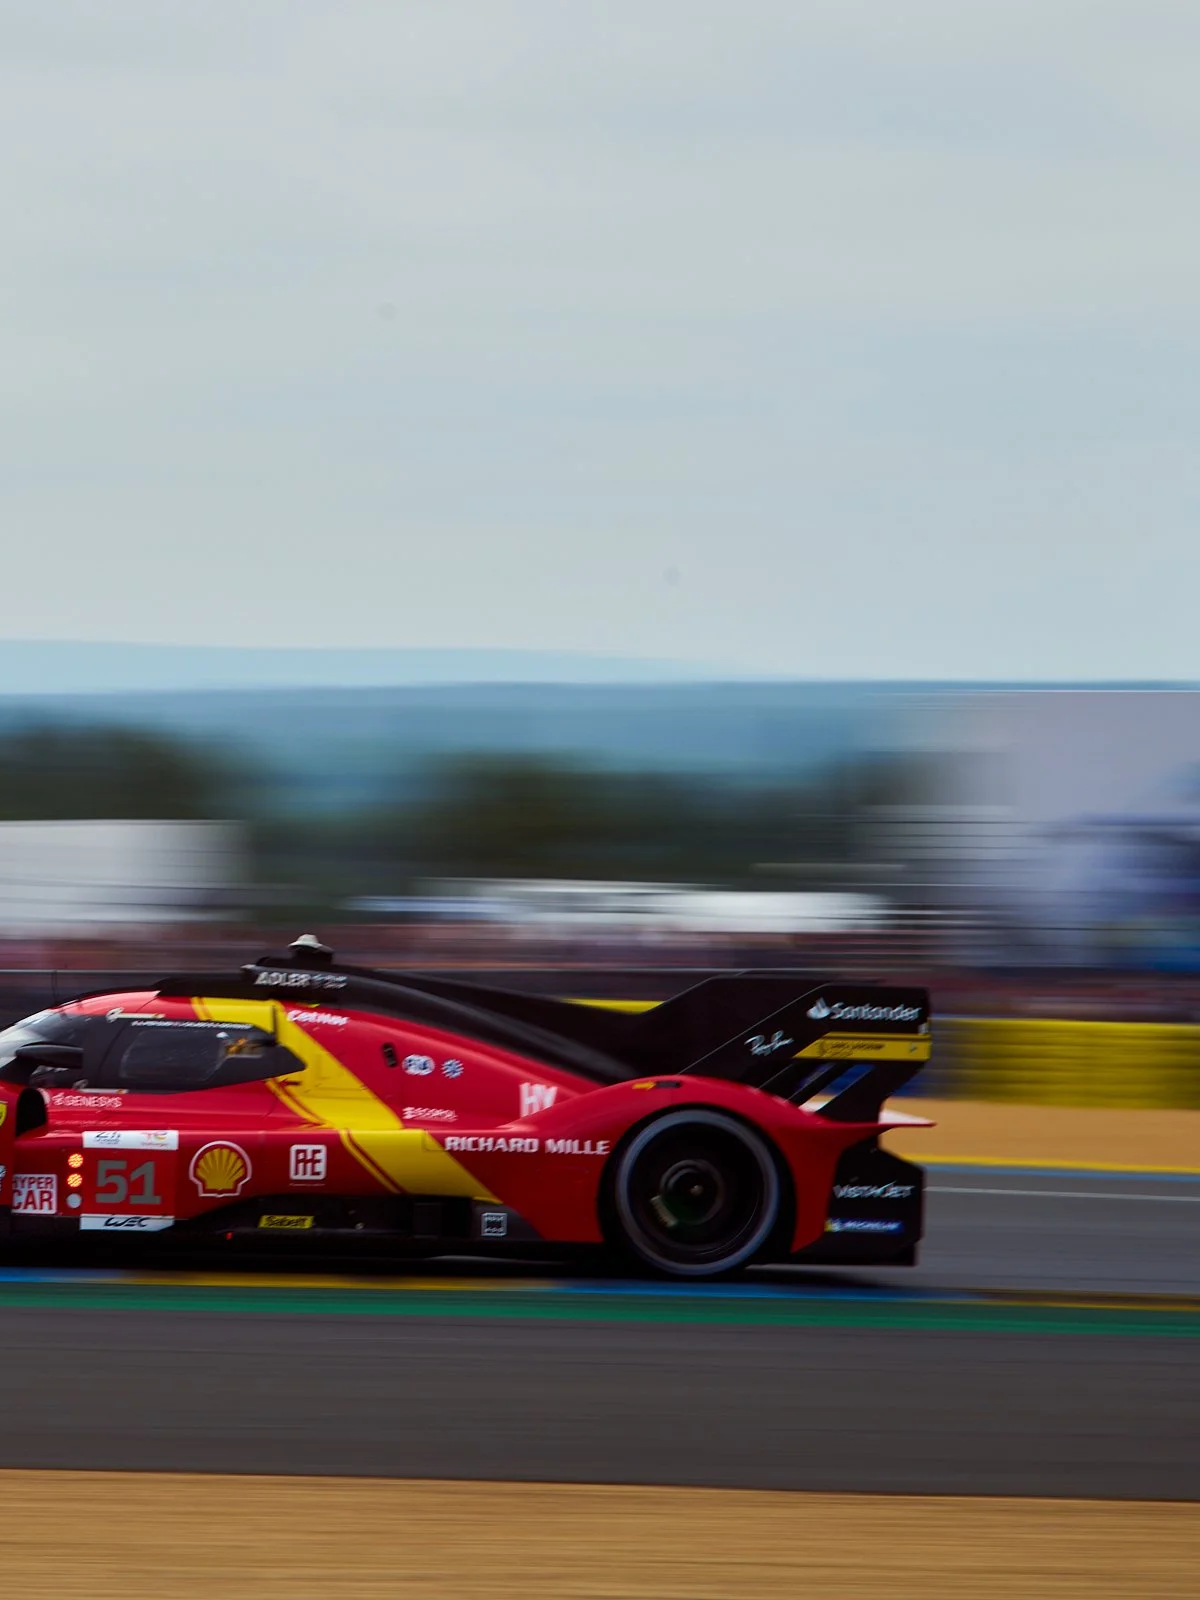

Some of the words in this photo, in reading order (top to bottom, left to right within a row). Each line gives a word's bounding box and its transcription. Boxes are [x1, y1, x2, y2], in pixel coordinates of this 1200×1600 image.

[253, 971, 311, 988] ADLER
[830, 1002, 922, 1021] Santander
[64, 1094, 123, 1108] GENESYS
[444, 1136, 540, 1153] RICHARD
[544, 1138, 612, 1155] MILLE
[95, 1159, 162, 1205] 51
[12, 1190, 53, 1211] CAR
[103, 1216, 150, 1228] WEC
